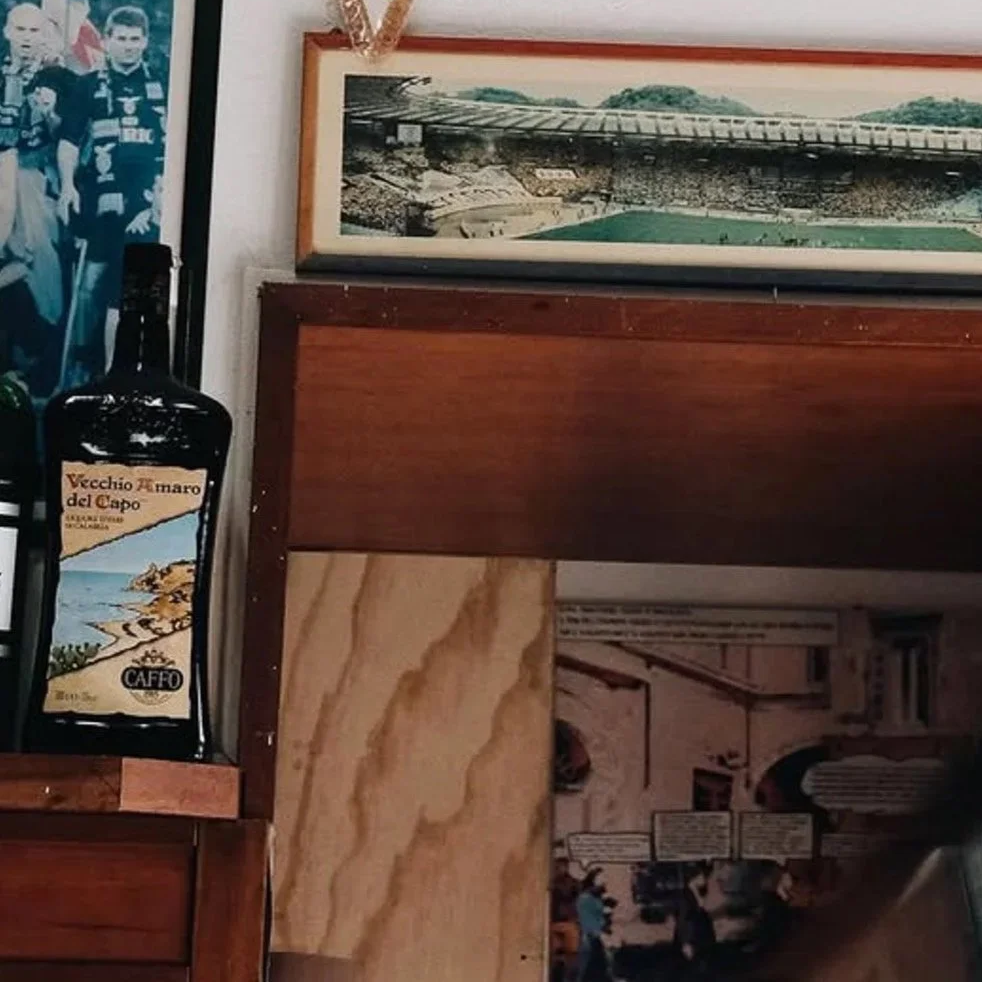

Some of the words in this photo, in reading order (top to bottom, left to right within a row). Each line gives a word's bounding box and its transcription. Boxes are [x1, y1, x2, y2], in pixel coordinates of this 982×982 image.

[66, 473, 133, 492] Vecchio
[136, 478, 201, 495] Amaro
[66, 493, 91, 508] del
[95, 494, 141, 513] Capo
[124, 668, 181, 689] CAFFO
